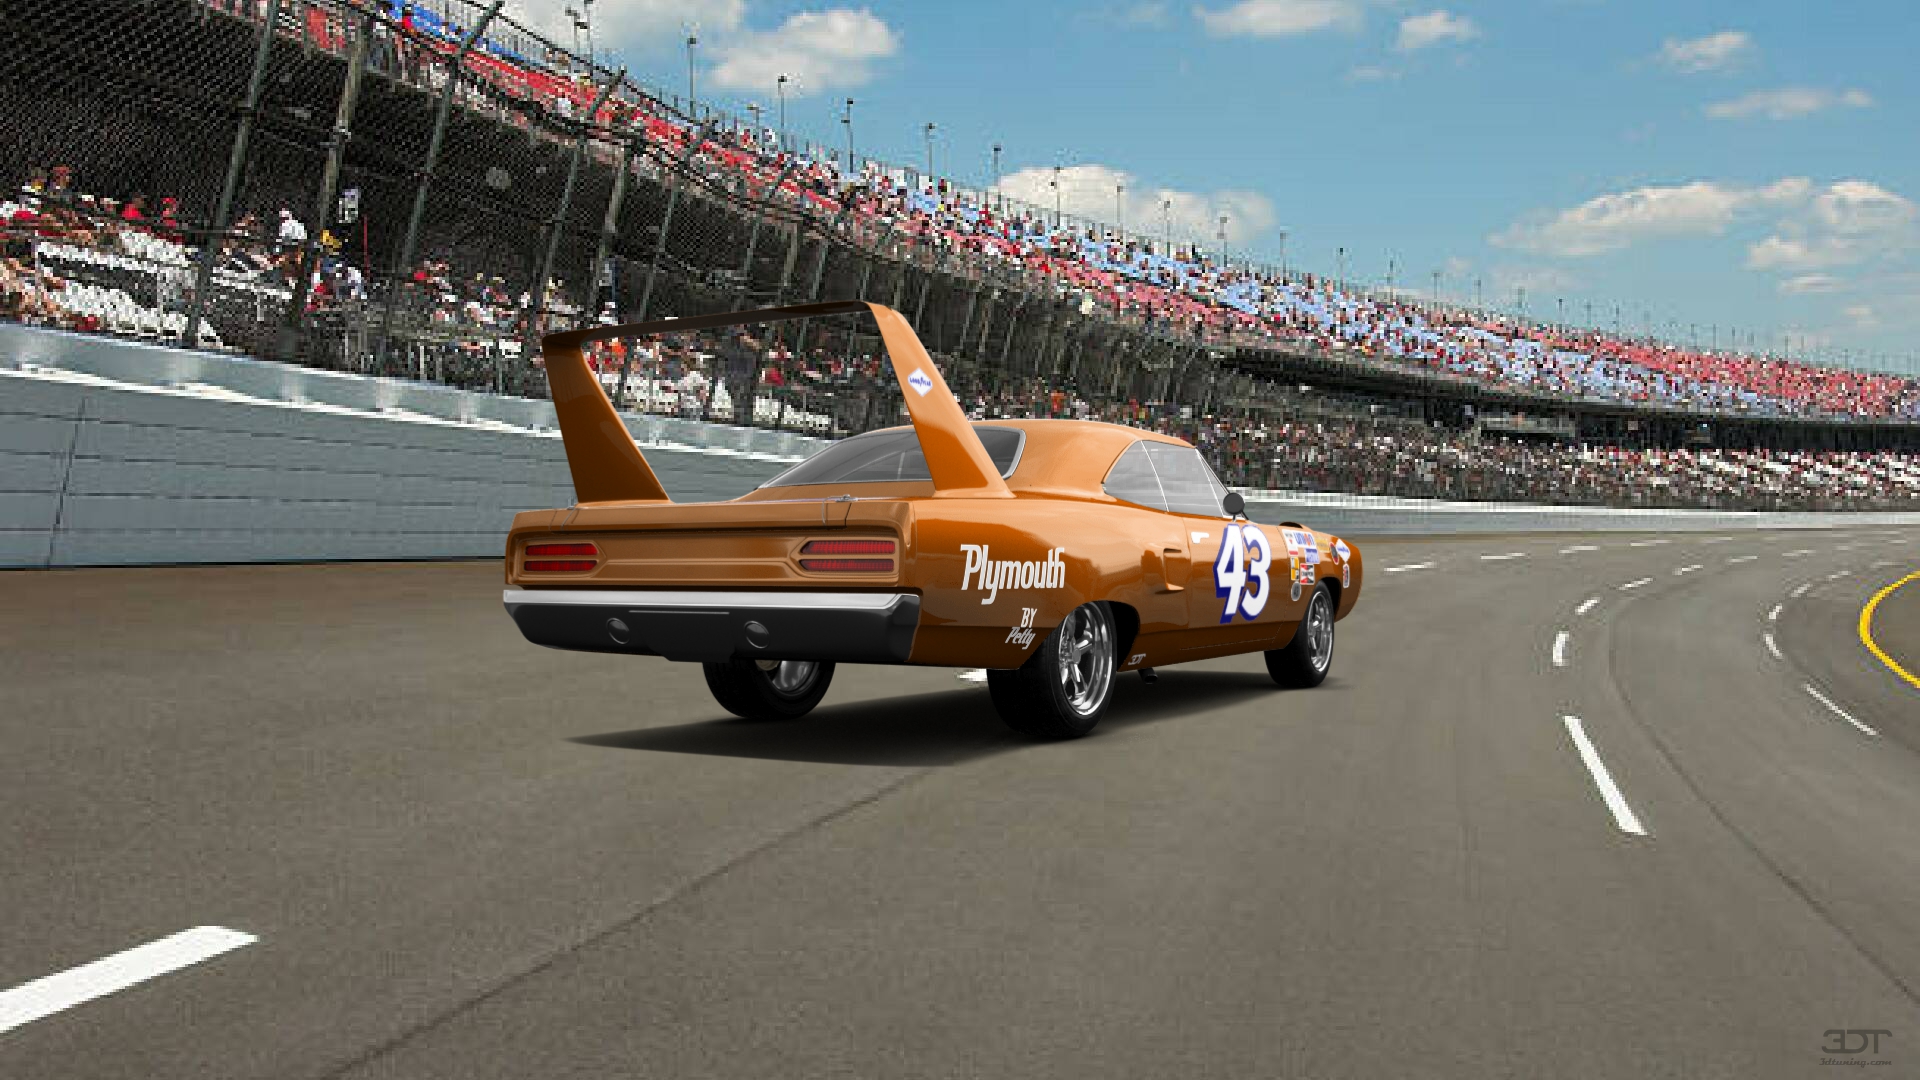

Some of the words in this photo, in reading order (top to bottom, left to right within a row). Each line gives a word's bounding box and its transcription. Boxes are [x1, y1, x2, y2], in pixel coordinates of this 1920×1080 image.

[960, 543, 1066, 605] Plymouth
[1213, 523, 1272, 624] 43
[1004, 626, 1036, 650] Petty
[1020, 607, 1037, 628] BY
